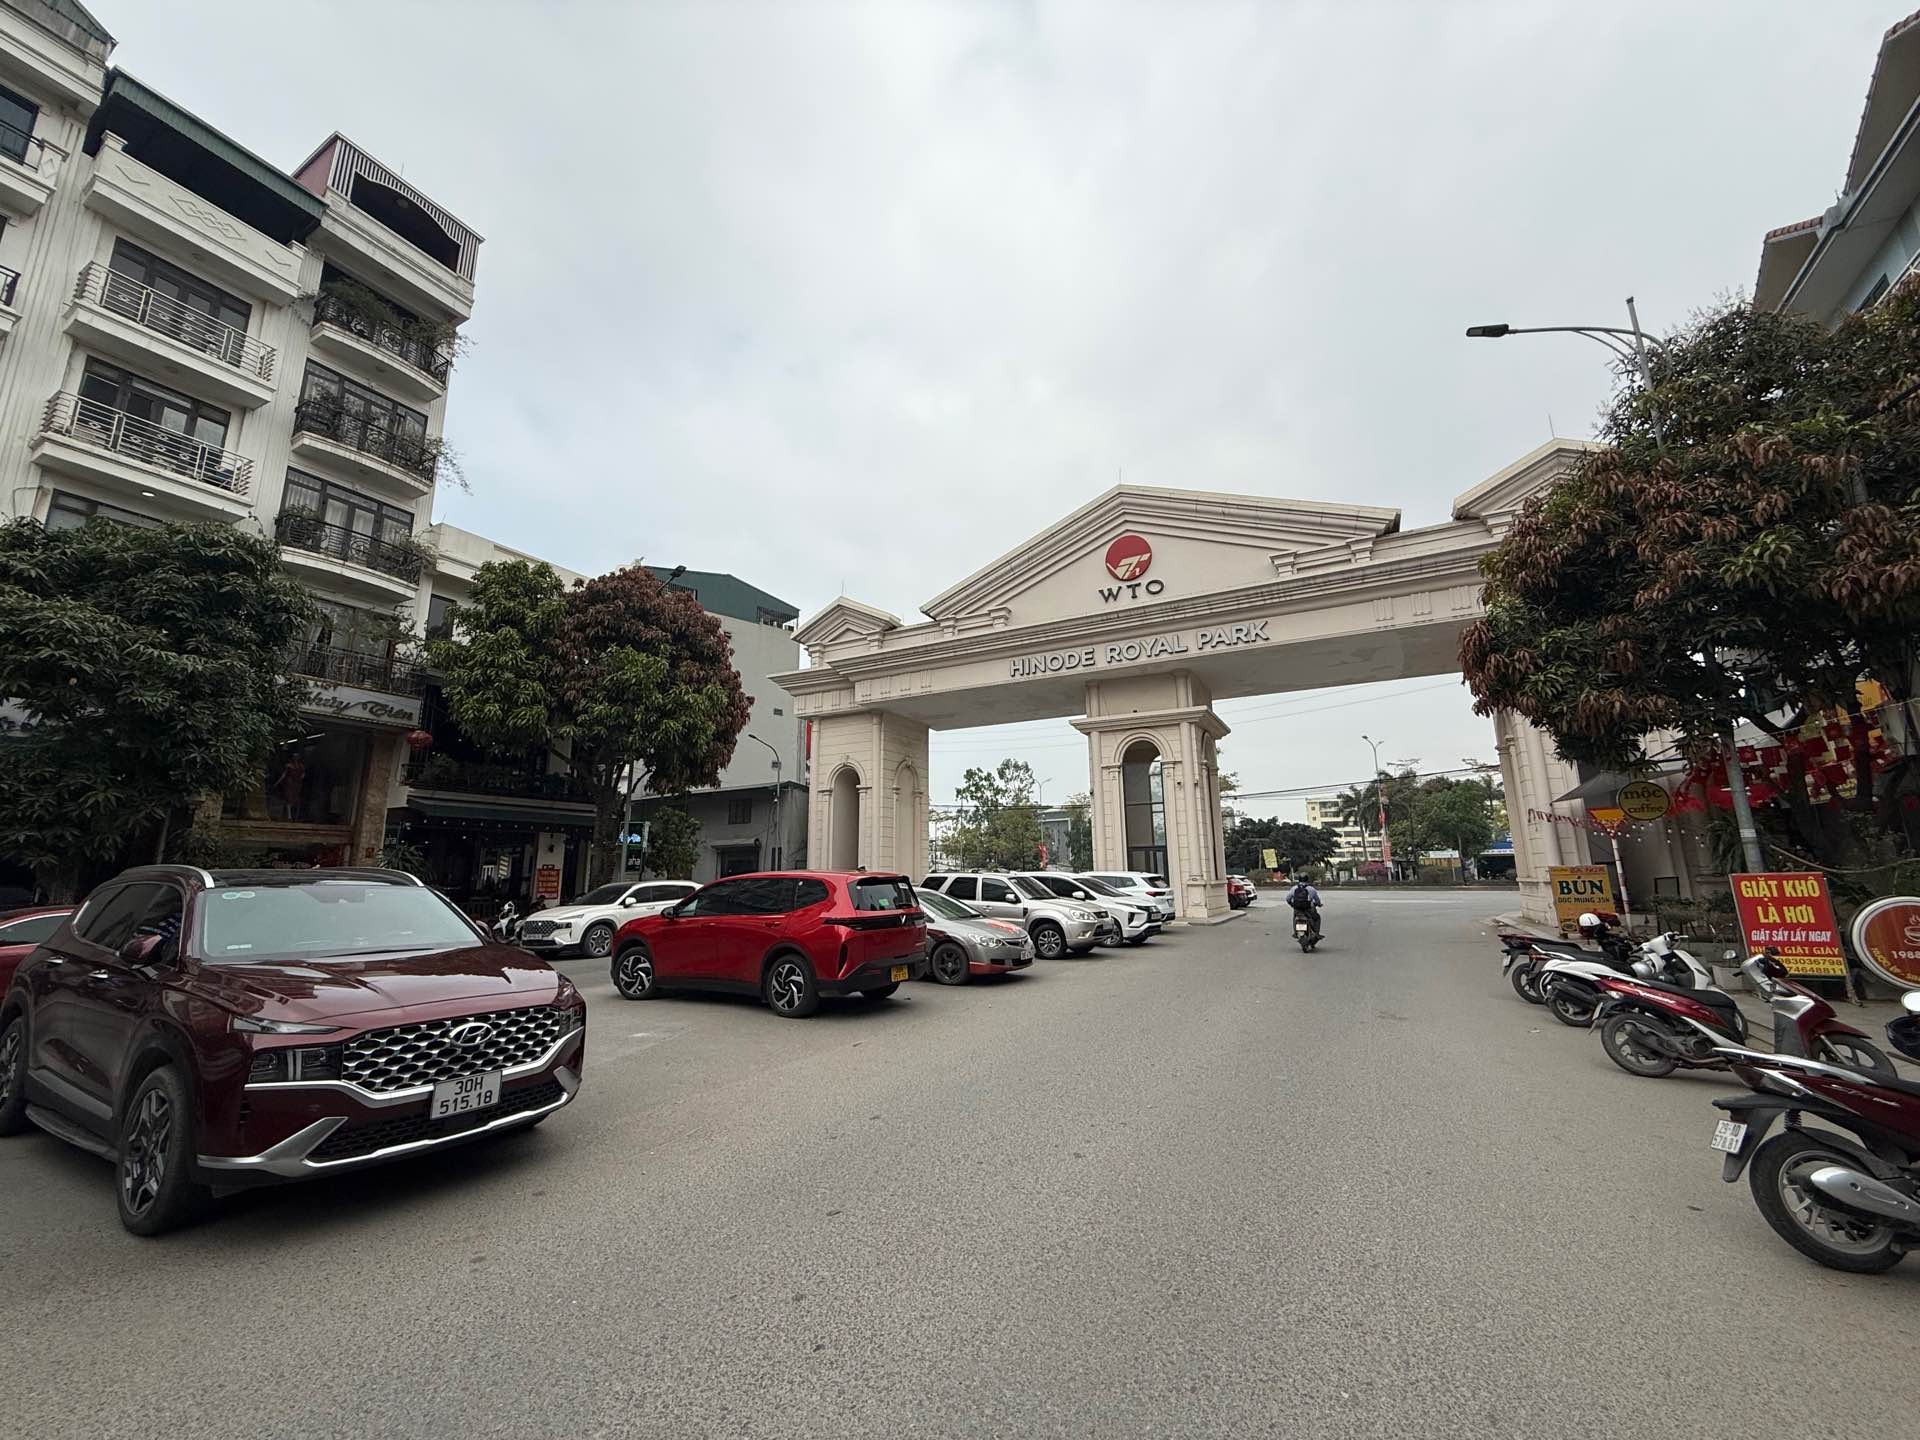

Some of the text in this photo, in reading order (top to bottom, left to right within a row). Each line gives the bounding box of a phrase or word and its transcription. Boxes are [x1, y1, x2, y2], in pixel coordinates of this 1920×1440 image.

[1098, 579, 1164, 603] WTO
[1009, 620, 1270, 677] HINODE ROYAL PARK
[1740, 876, 1821, 901] GIẶT KHÔ
[1757, 902, 1816, 924] LÀ HƠI
[1751, 926, 1832, 944] GIẶT SẤY LẤY NGAY
[454, 1076, 484, 1095] 30H
[439, 1090, 493, 1114] 515.18
